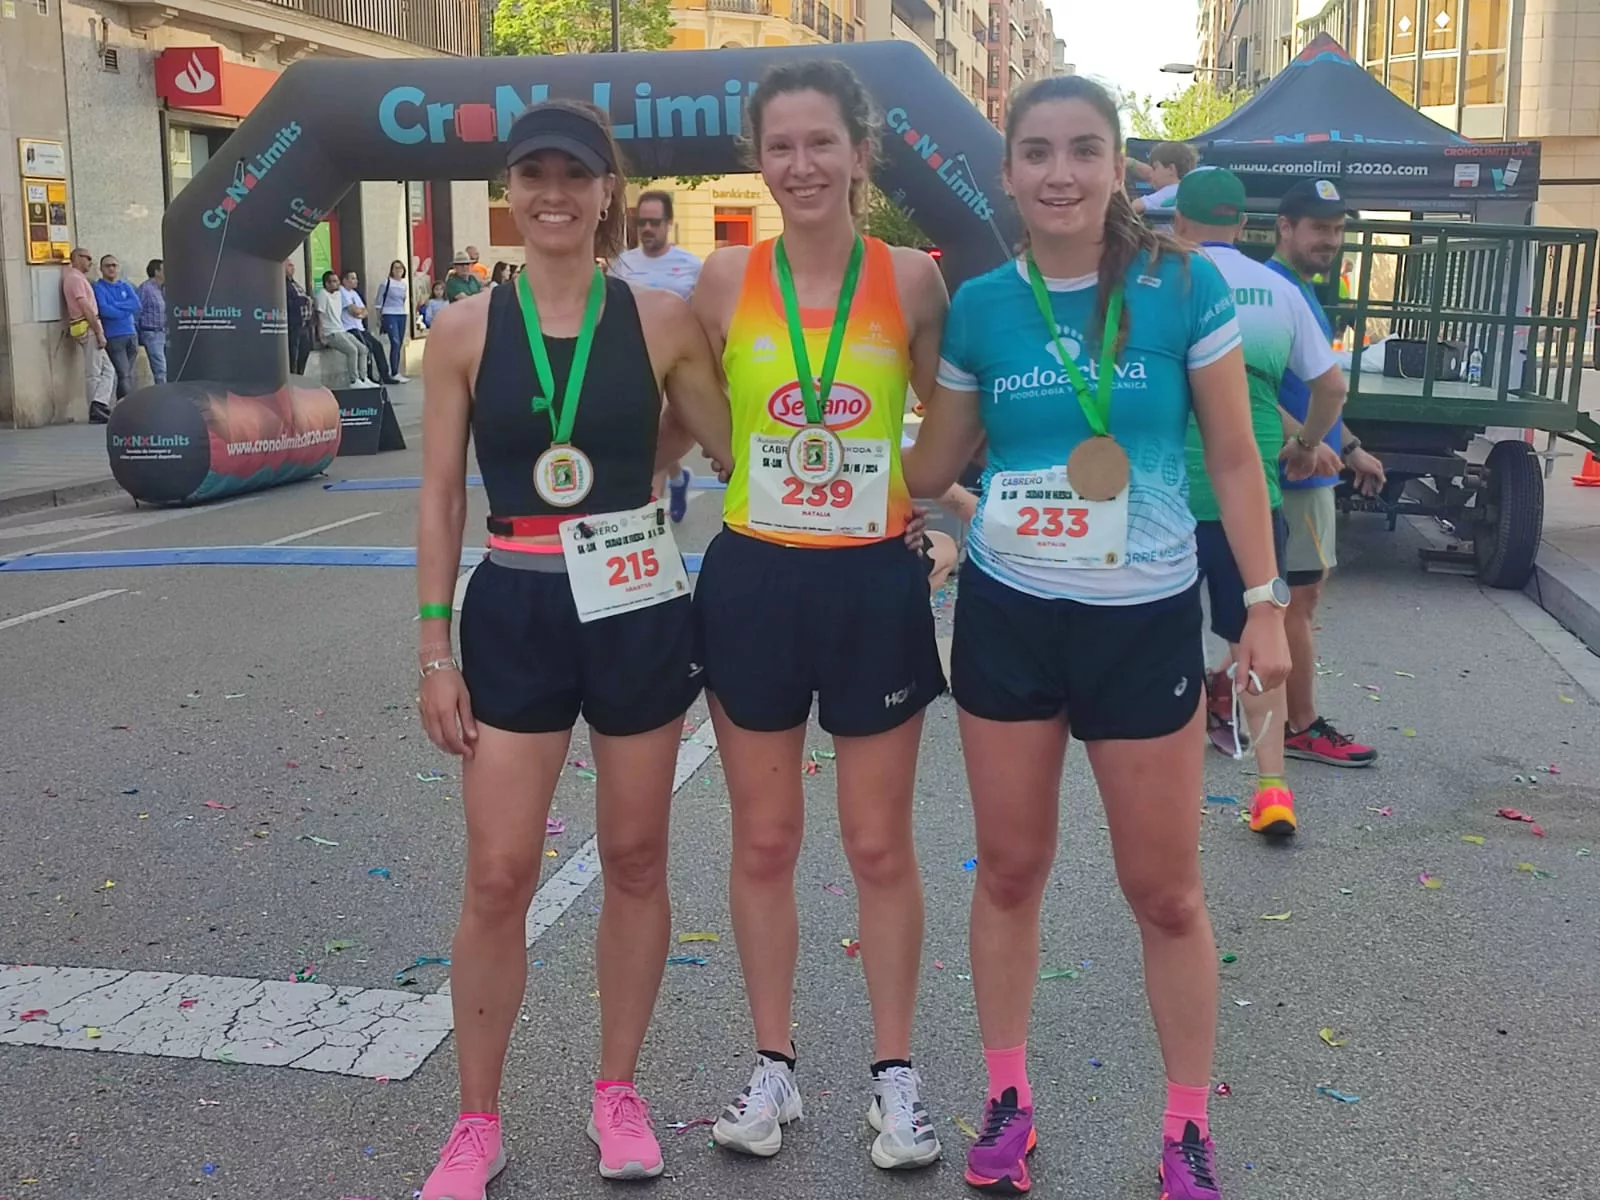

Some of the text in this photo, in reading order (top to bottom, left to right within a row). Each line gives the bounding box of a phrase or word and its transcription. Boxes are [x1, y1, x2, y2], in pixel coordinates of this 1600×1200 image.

[777, 393, 863, 417] Seano
[781, 476, 853, 509] 239
[801, 510, 832, 518] NATALIA
[1016, 506, 1089, 538] 233
[606, 548, 660, 587] 215
